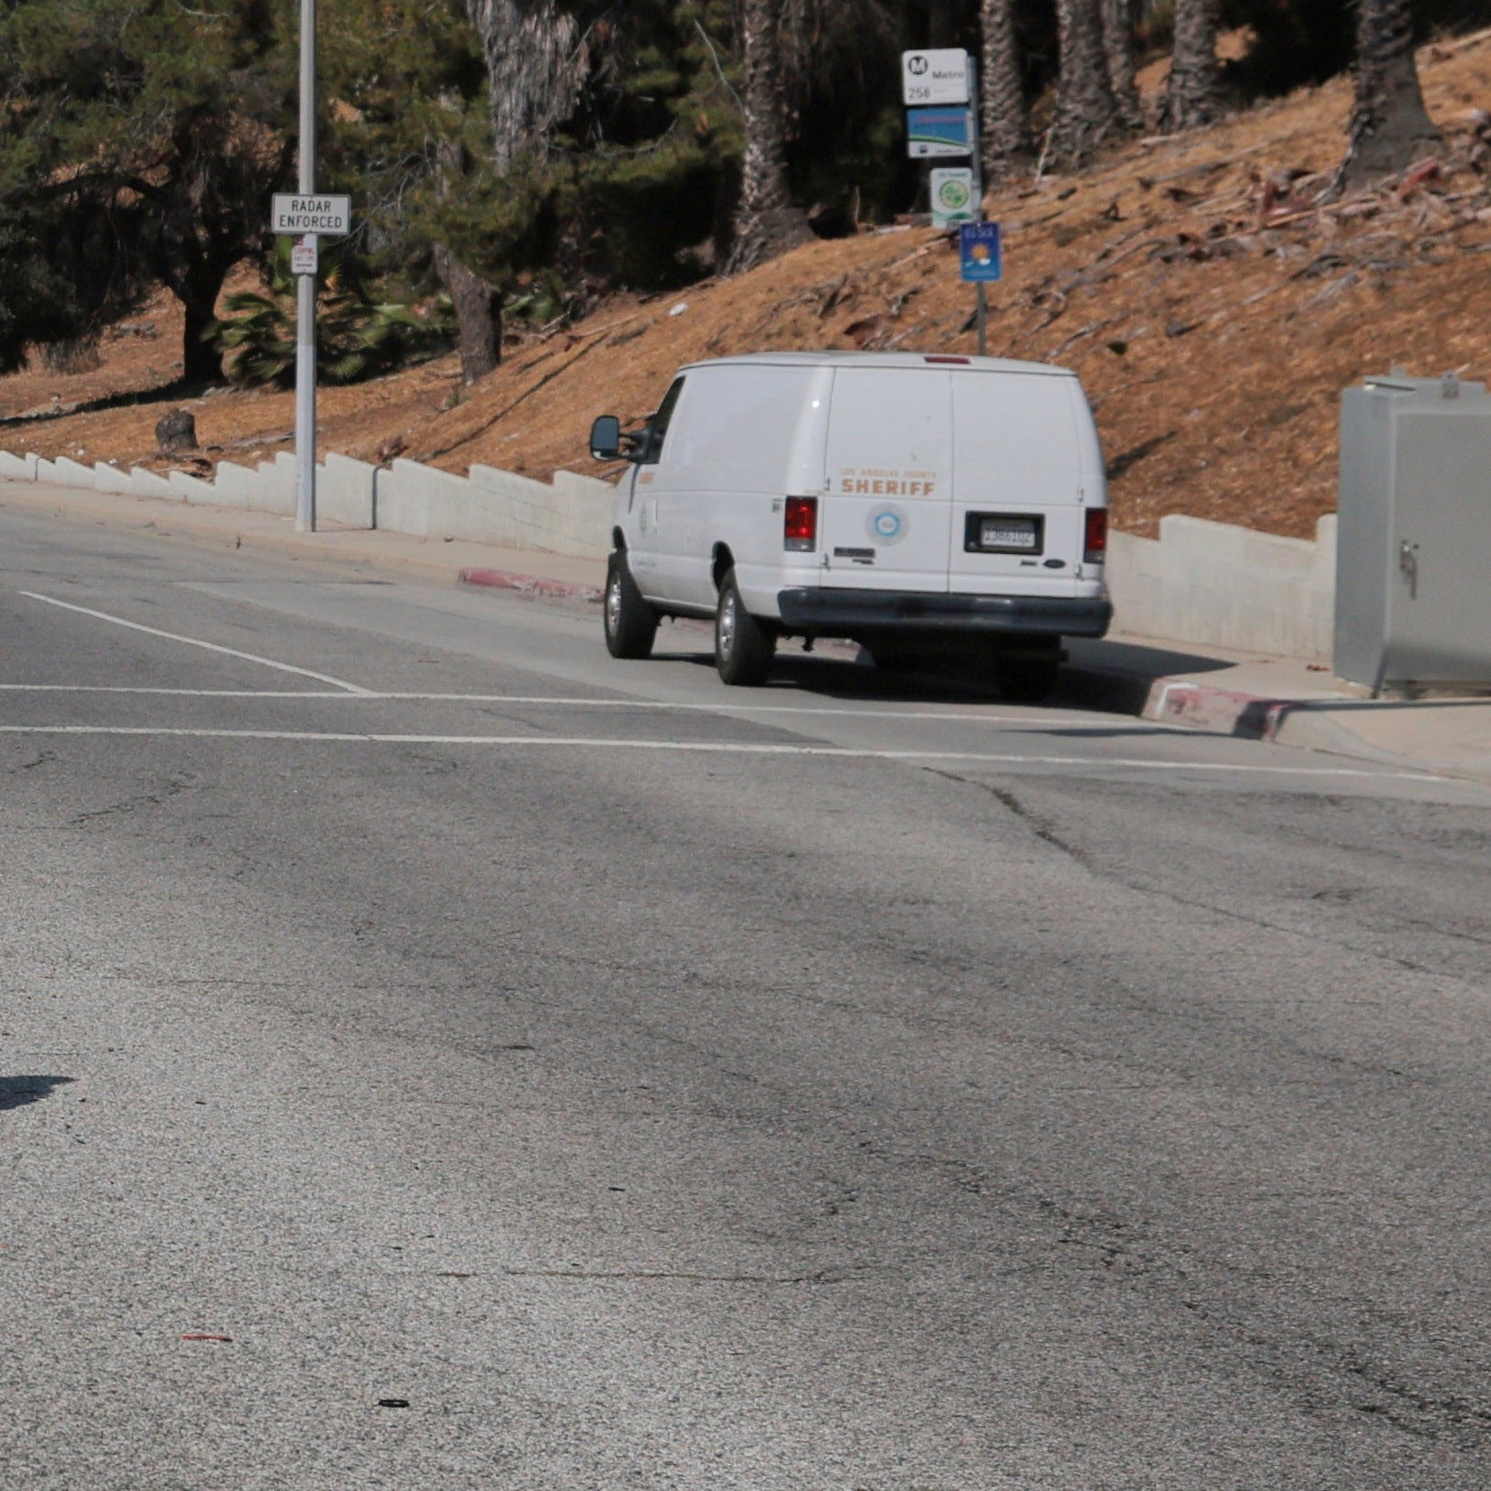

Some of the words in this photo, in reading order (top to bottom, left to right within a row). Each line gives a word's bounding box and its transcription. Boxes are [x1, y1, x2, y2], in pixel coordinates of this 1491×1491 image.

[932, 70, 965, 79] Metro
[908, 87, 931, 99] 258
[291, 200, 332, 212] RADAR
[279, 215, 342, 228] ENFORCED
[842, 478, 935, 496] SHERIFF
